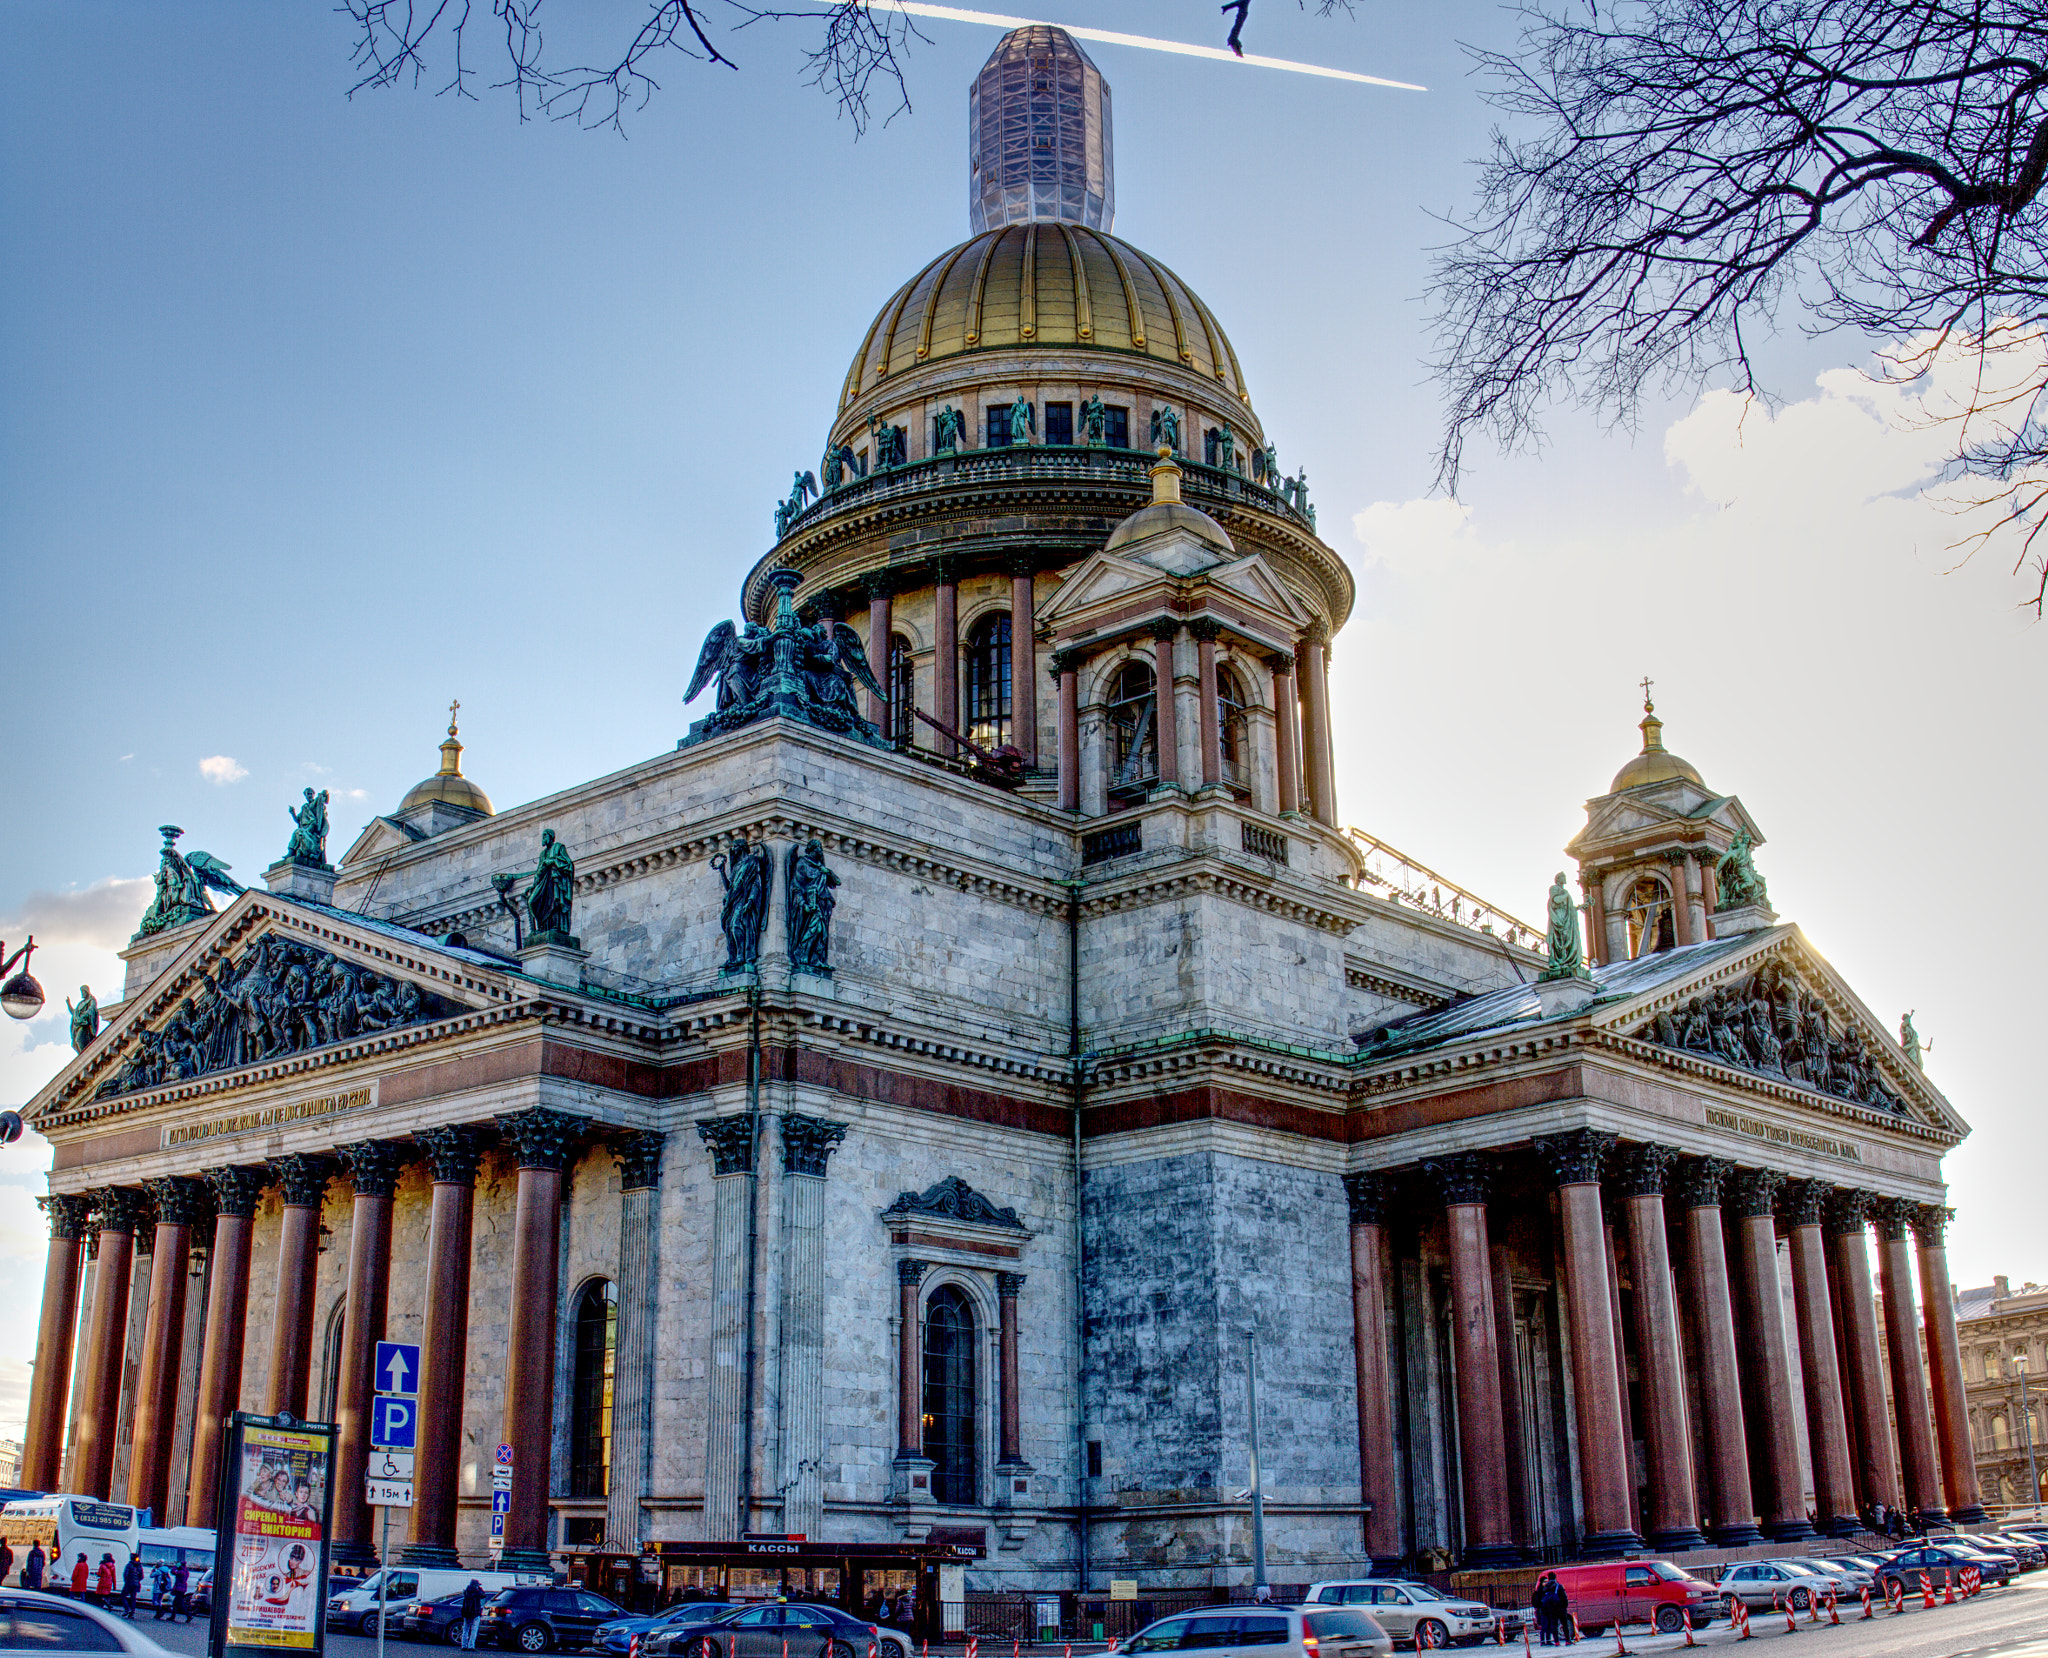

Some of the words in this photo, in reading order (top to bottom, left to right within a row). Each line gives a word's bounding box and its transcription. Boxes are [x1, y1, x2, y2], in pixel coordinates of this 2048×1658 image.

[384, 1403, 409, 1441] P
[80, 1515, 98, 1523] (812)
[244, 1509, 277, 1523] СИРЕНА
[260, 1523, 312, 1538] ВИКТОРИЯ
[493, 1516, 502, 1534] P
[241, 1545, 249, 1557] 21
[748, 1544, 799, 1553] КАССЫ
[956, 1546, 977, 1556] КАССЫ
